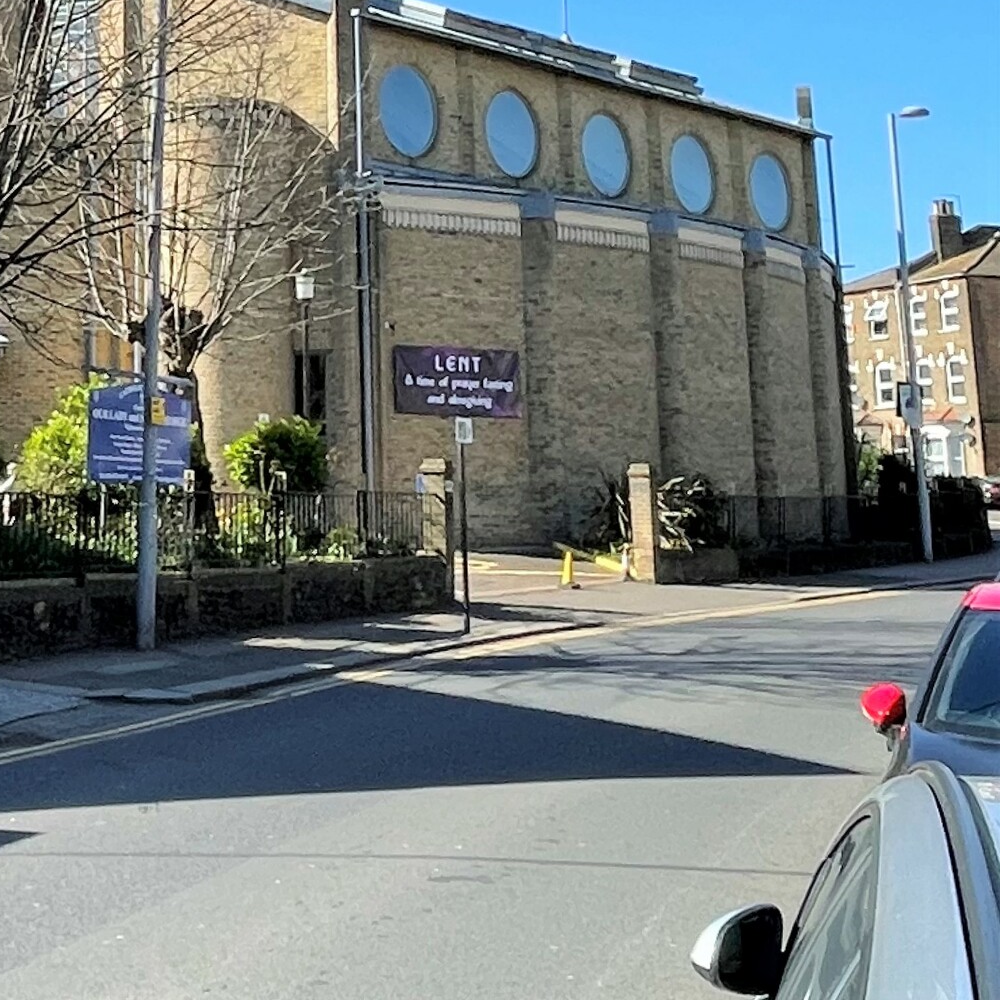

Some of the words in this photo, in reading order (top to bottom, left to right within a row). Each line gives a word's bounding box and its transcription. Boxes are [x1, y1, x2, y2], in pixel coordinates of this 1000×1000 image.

[434, 354, 481, 373] LENT
[404, 373, 414, 386] A
[438, 375, 449, 387] of
[426, 393, 445, 404] and
